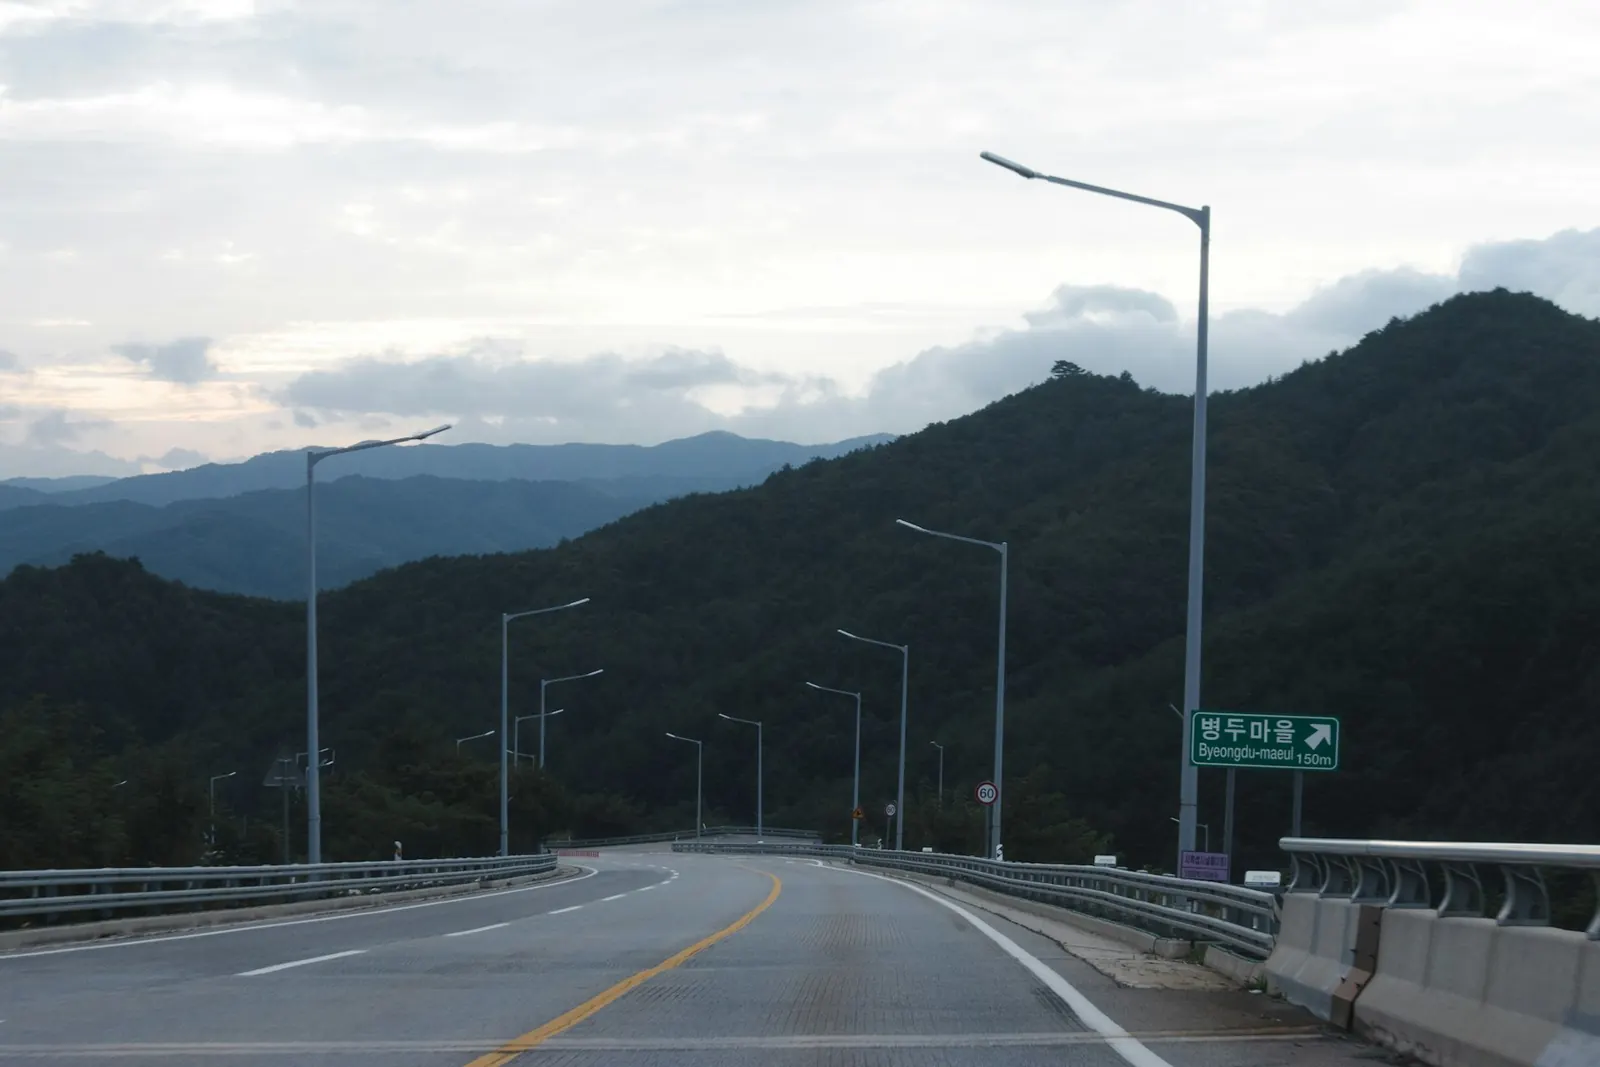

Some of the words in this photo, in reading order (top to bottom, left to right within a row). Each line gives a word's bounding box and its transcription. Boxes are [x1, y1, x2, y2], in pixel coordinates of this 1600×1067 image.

[1201, 717, 1296, 744] 병두마을
[1198, 742, 1294, 762] Byeongdu-maeul
[1297, 753, 1332, 765] 150m
[980, 788, 994, 799] 60
